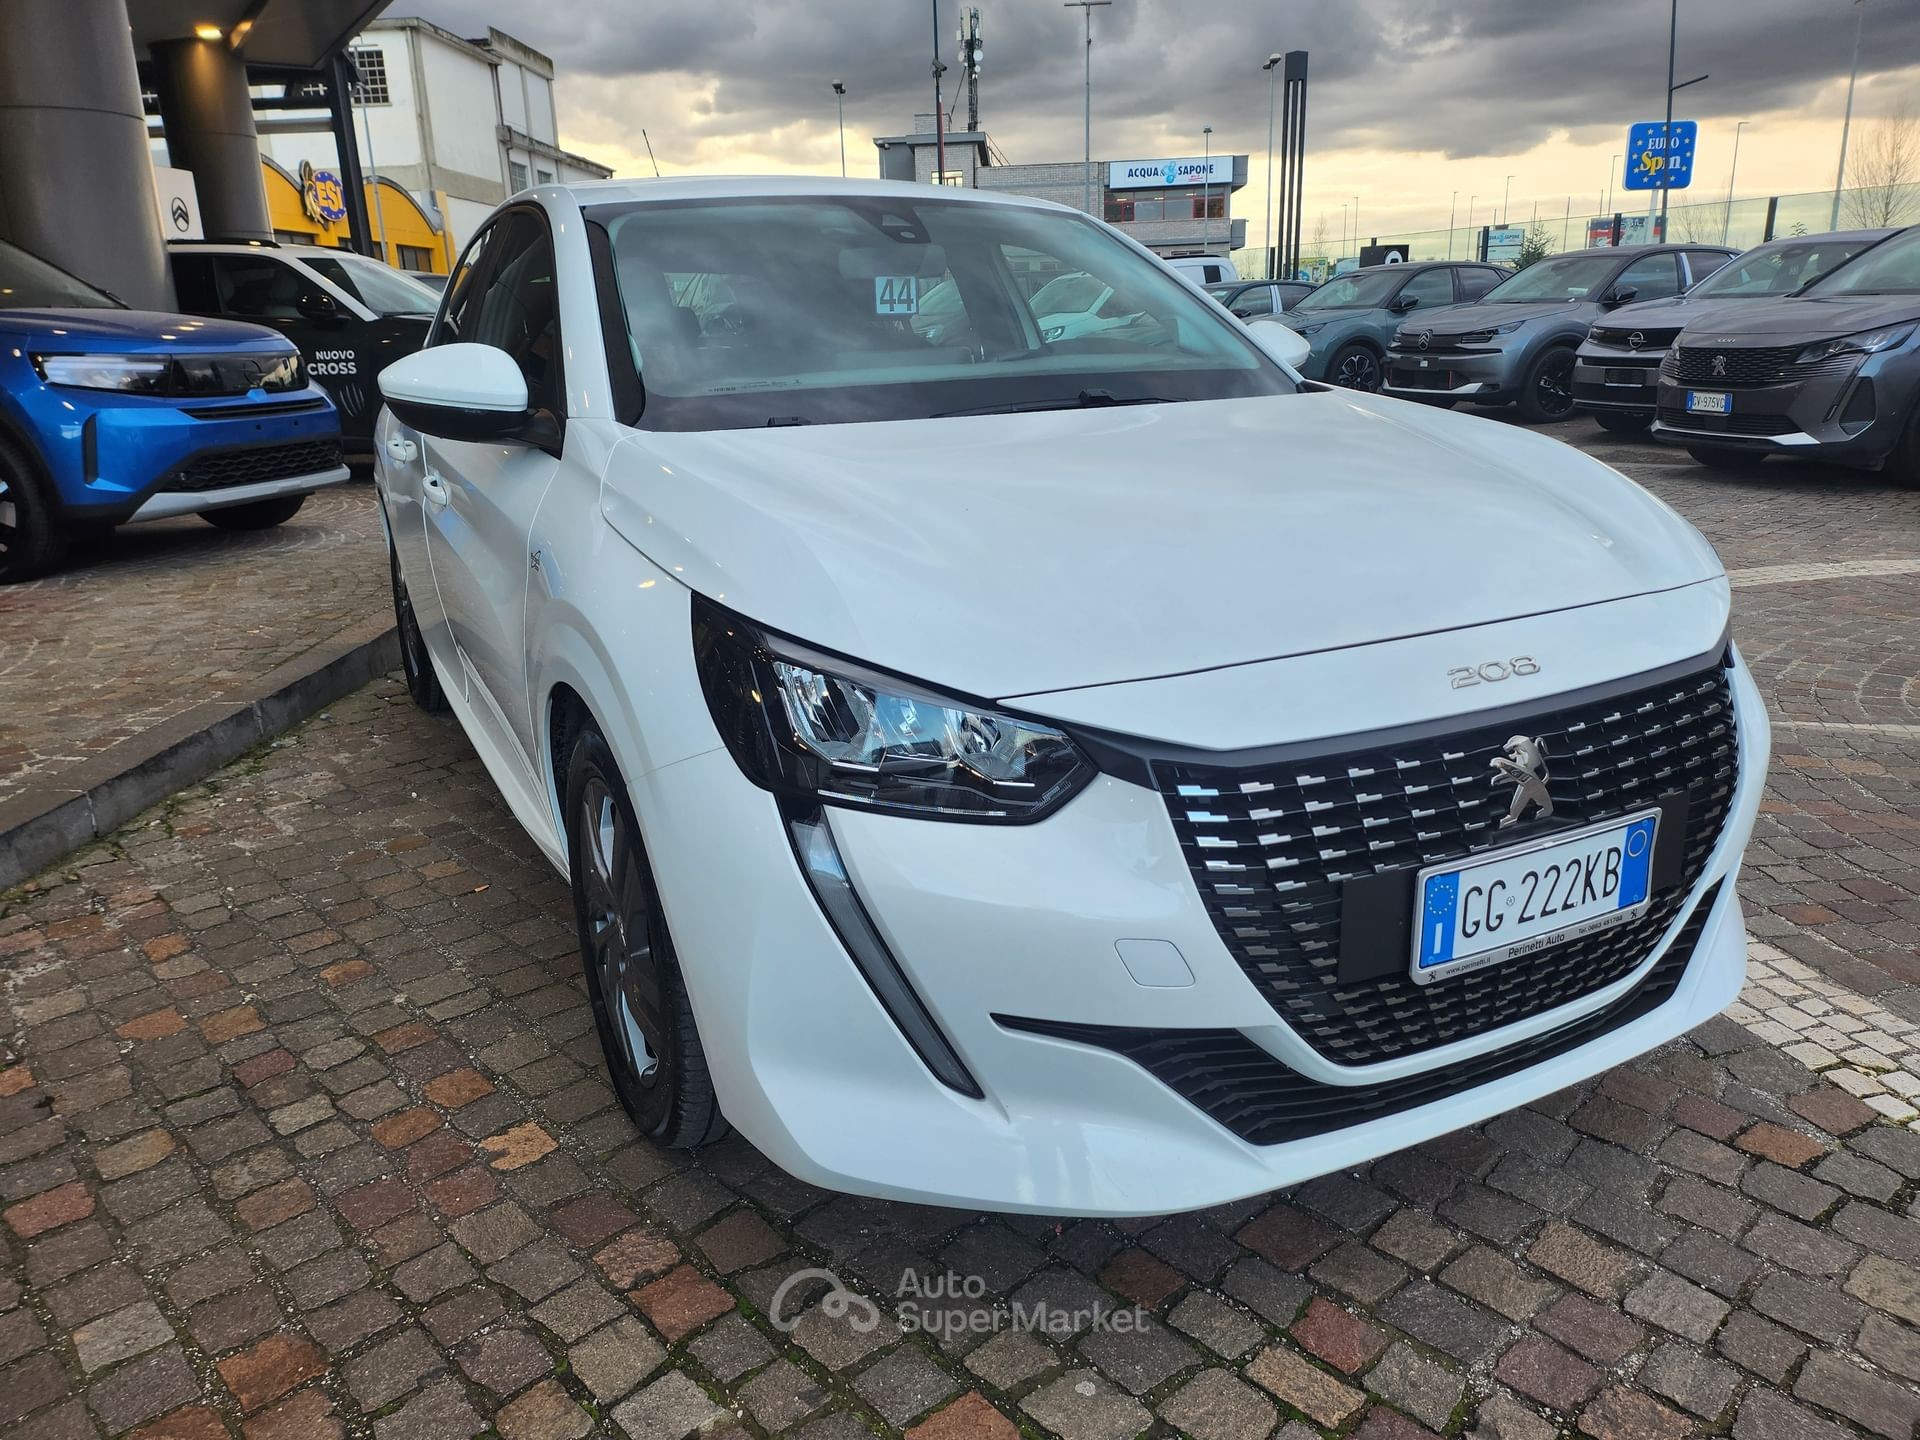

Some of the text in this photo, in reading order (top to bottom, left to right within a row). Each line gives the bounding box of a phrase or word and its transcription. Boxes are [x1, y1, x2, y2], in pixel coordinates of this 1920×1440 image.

[1128, 167, 1159, 178] ACQUA
[1178, 163, 1214, 175] SAPONE
[879, 278, 914, 312] 44
[307, 362, 357, 375] CROSS
[315, 350, 355, 360] NUOVO
[1447, 655, 1541, 689] 208
[1462, 847, 1621, 938] GG 222KB
[1446, 957, 1491, 974] www.perinetti.it
[1508, 938, 1544, 958] Perinetti
[1546, 933, 1565, 946] Auto
